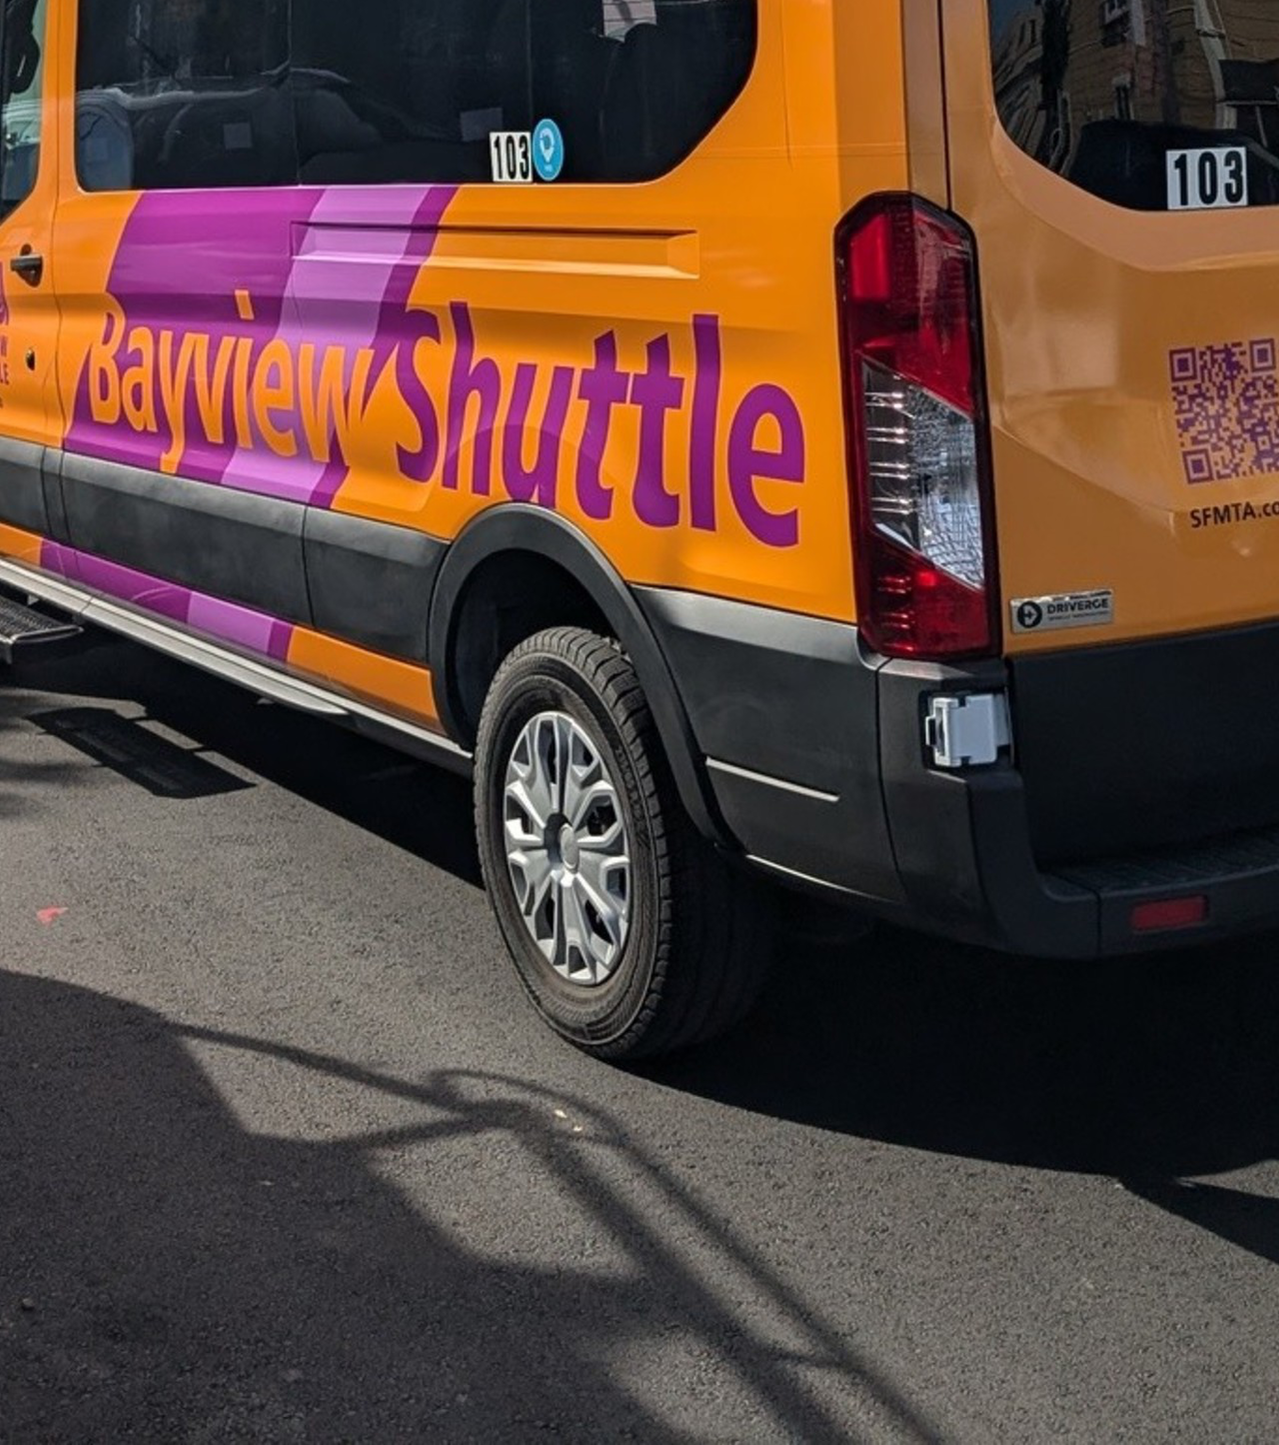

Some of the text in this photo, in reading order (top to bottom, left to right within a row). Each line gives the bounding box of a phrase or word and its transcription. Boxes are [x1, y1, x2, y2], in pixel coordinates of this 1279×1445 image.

[494, 135, 530, 180] 103
[1173, 149, 1244, 206] 103
[87, 289, 806, 548] Bayview Shuttle
[1047, 597, 1109, 615] DRIVERGE
